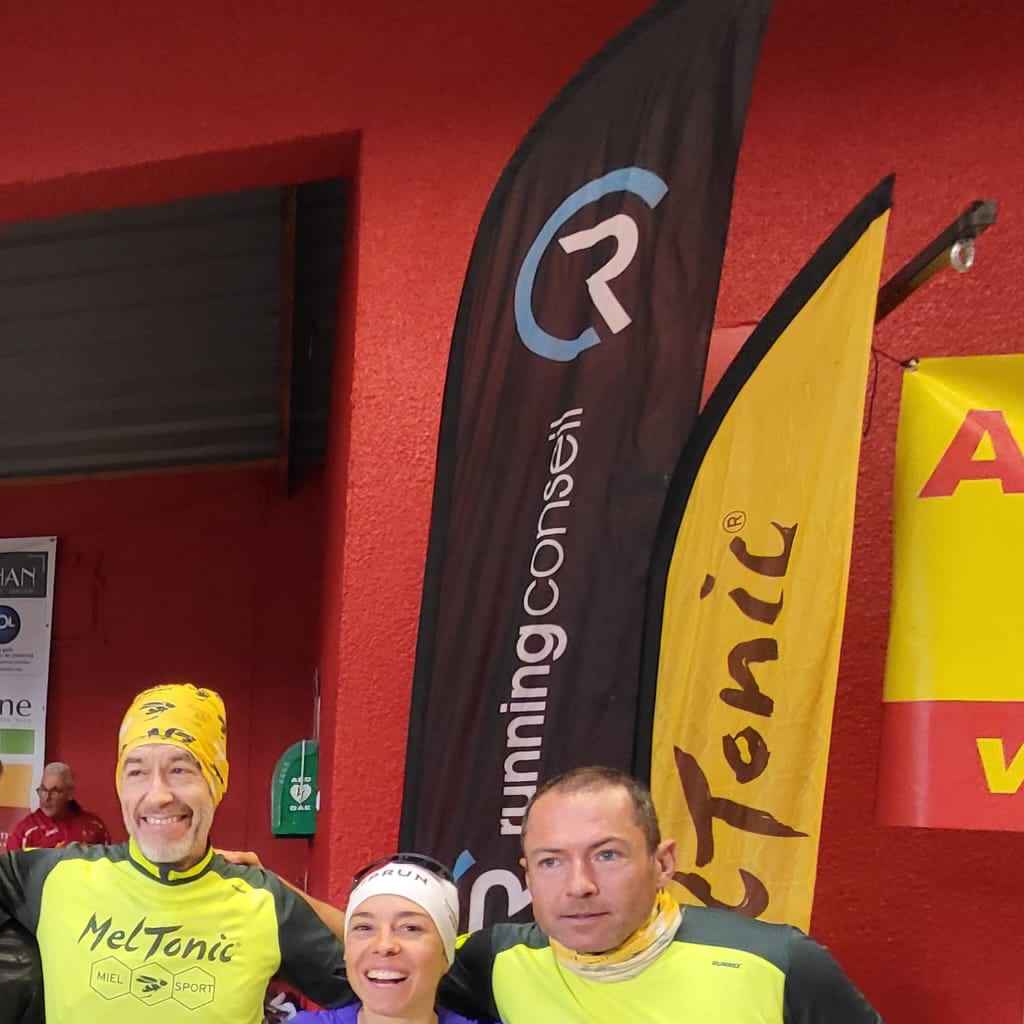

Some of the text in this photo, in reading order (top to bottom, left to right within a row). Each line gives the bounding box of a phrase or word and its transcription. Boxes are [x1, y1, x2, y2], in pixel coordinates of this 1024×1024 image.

[917, 408, 1024, 498] A
[368, 869, 428, 885] PRUN
[77, 911, 235, 963] MelTonic
[96, 971, 215, 994] MIEL SPORT
